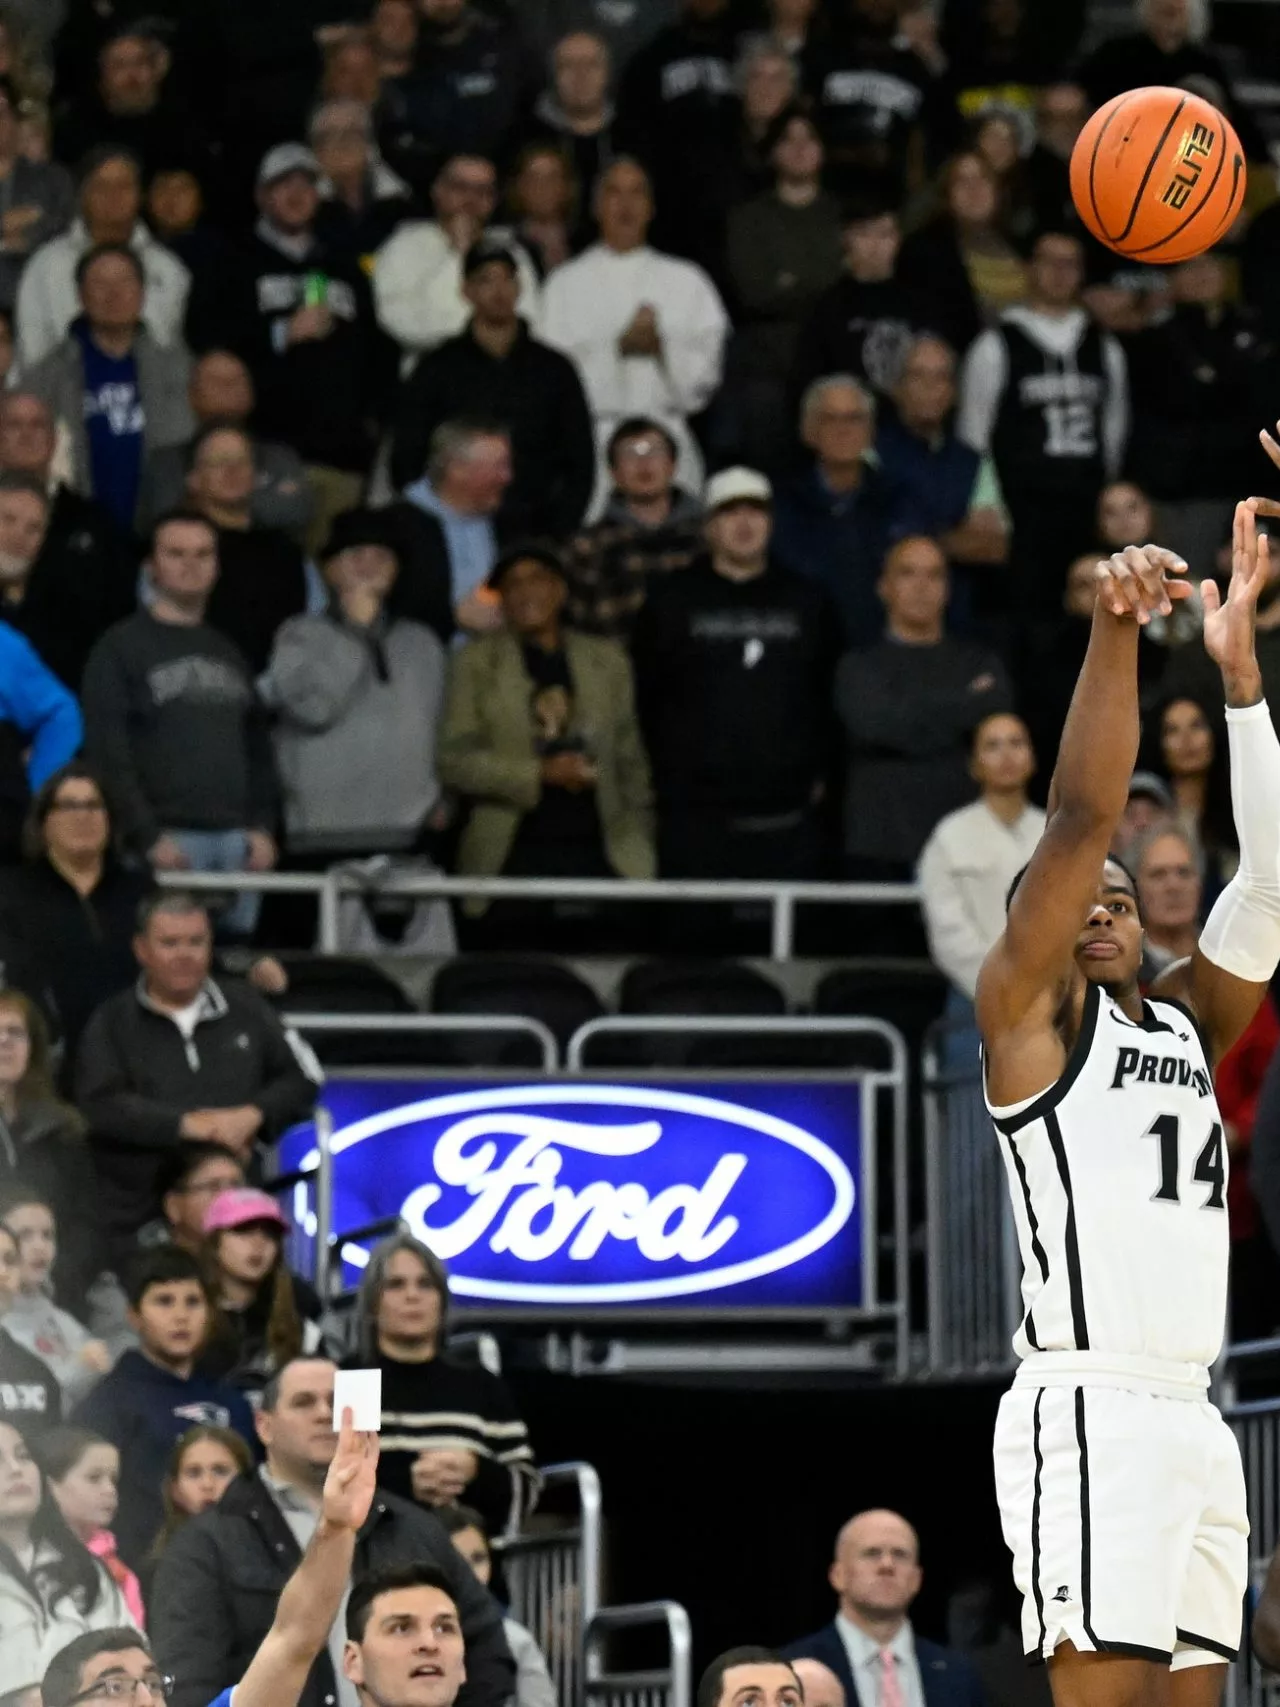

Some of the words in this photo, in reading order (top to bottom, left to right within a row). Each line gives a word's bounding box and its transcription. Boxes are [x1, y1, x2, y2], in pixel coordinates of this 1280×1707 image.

[1162, 122, 1215, 210] ELITE
[400, 1112, 748, 1262] Ford
[1141, 1111, 1225, 1211] 14
